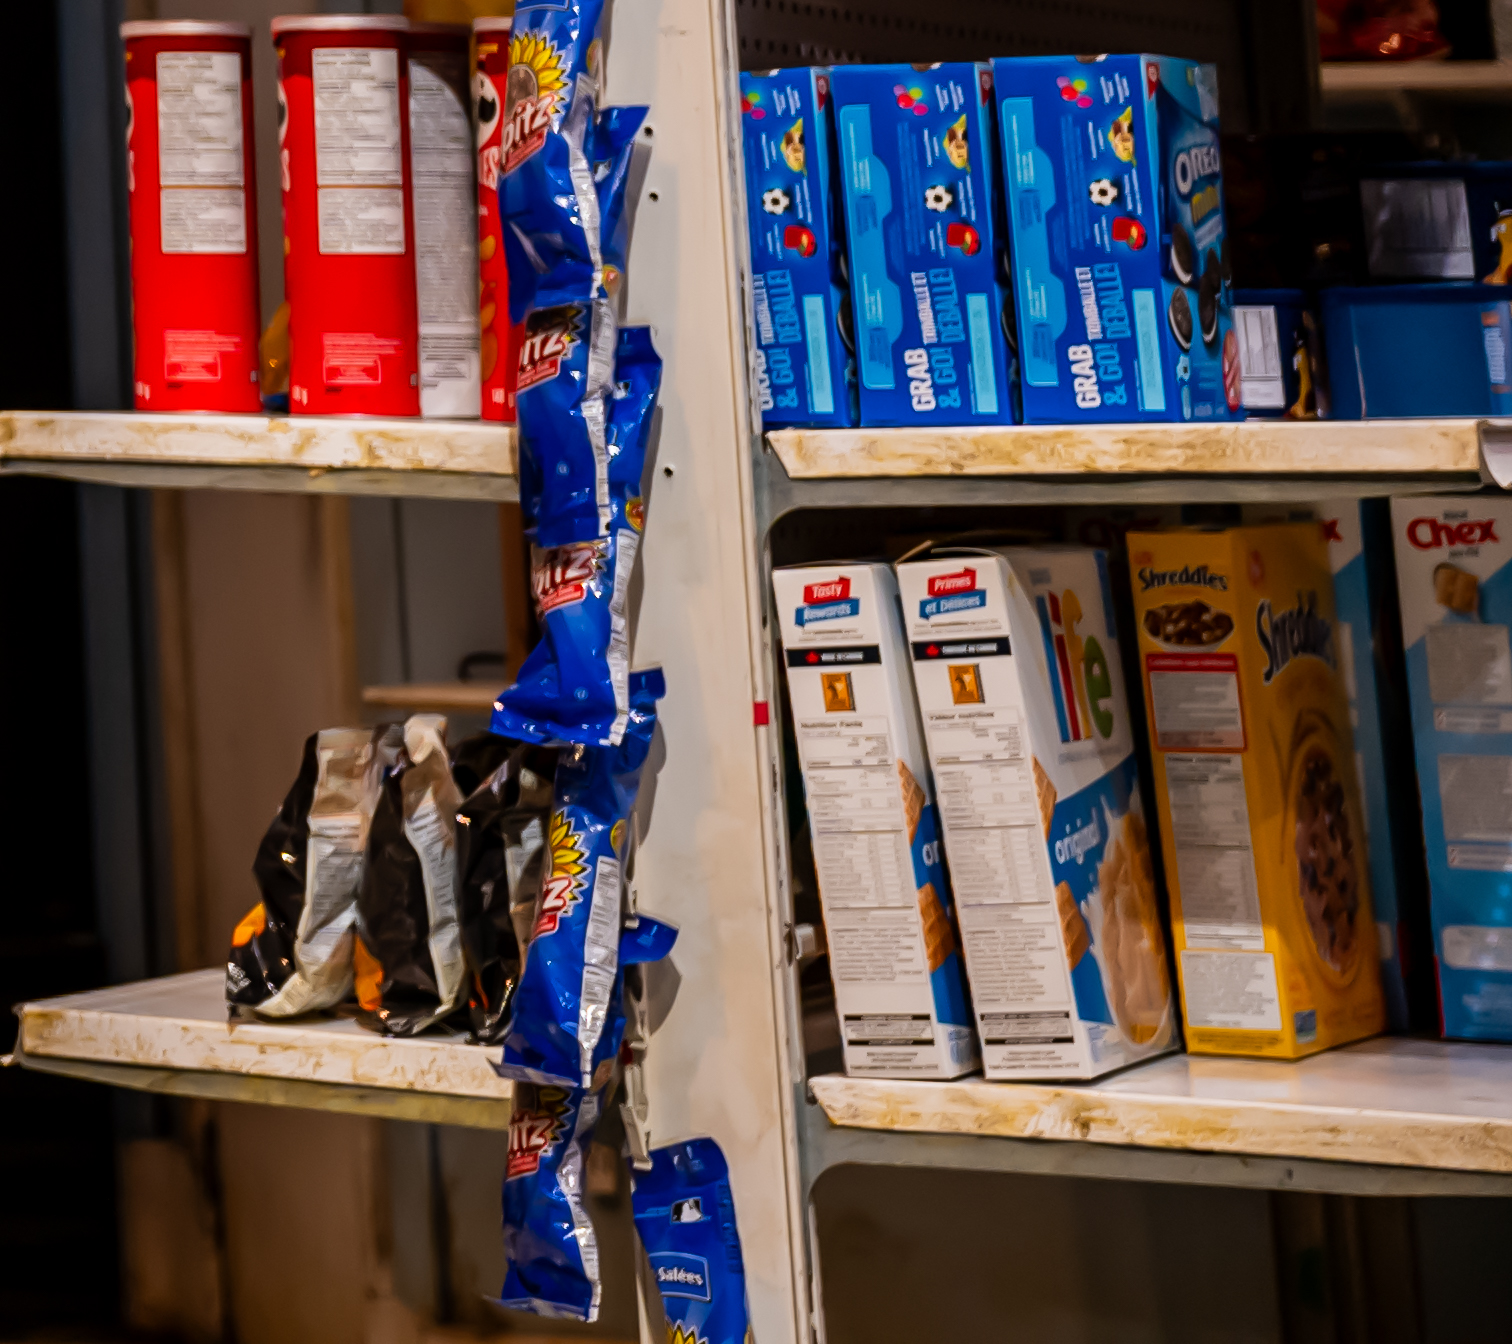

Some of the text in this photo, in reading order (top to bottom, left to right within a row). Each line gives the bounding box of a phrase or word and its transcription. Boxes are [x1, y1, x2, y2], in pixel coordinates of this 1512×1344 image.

[501, 92, 556, 164] pitz
[903, 348, 937, 413] GRAB
[1067, 344, 1102, 409] GRAB
[1406, 516, 1500, 551] Chex
[811, 582, 843, 600] Tasty
[933, 575, 972, 593] Primes
[1137, 564, 1229, 592] Shreddies
[1036, 588, 1114, 743] life
